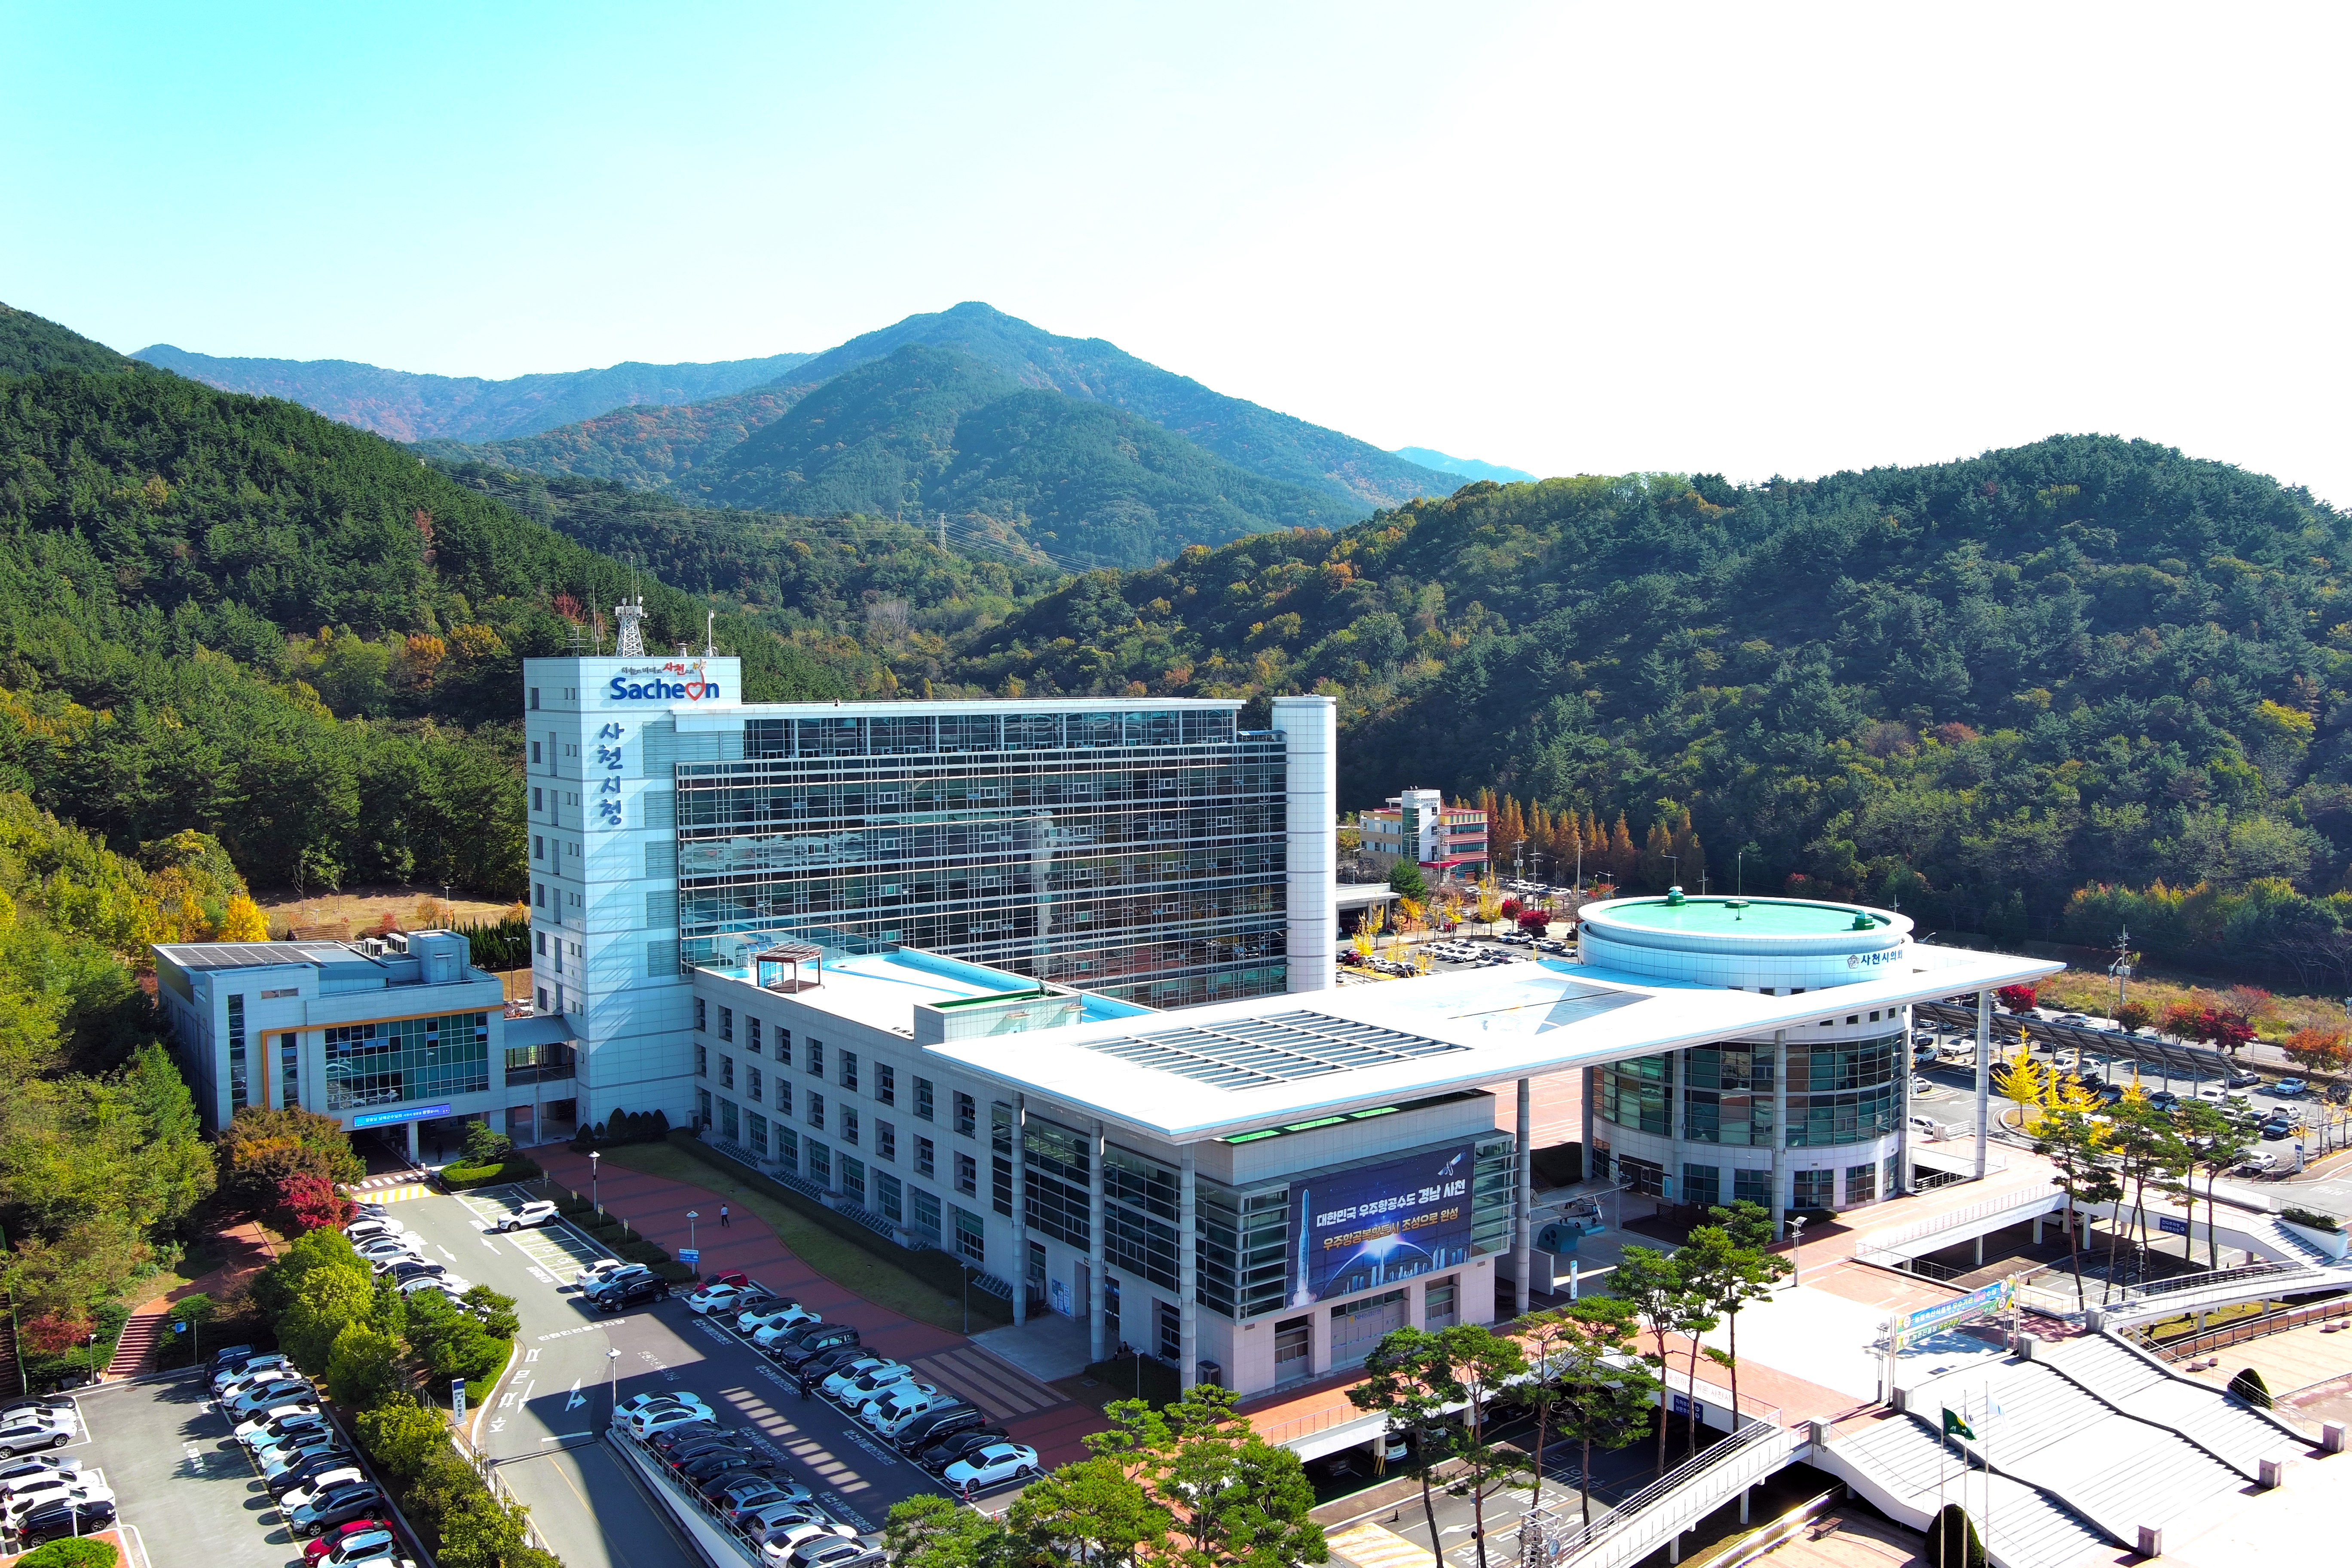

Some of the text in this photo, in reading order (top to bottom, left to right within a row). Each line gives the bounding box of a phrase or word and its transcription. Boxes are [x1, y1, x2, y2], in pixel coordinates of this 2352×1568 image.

[598, 722, 625, 826] 사천시청
[1860, 949, 1903, 966] 사천시의회
[1316, 1179, 1466, 1228] 대한민국 우주항공수도 경남 사천
[1323, 1207, 1459, 1251] 우주항공복합도시 조성으로 완성
[537, 1318, 626, 1341] 민원인전용주차장
[1711, 1389, 1731, 1402] 사천시
